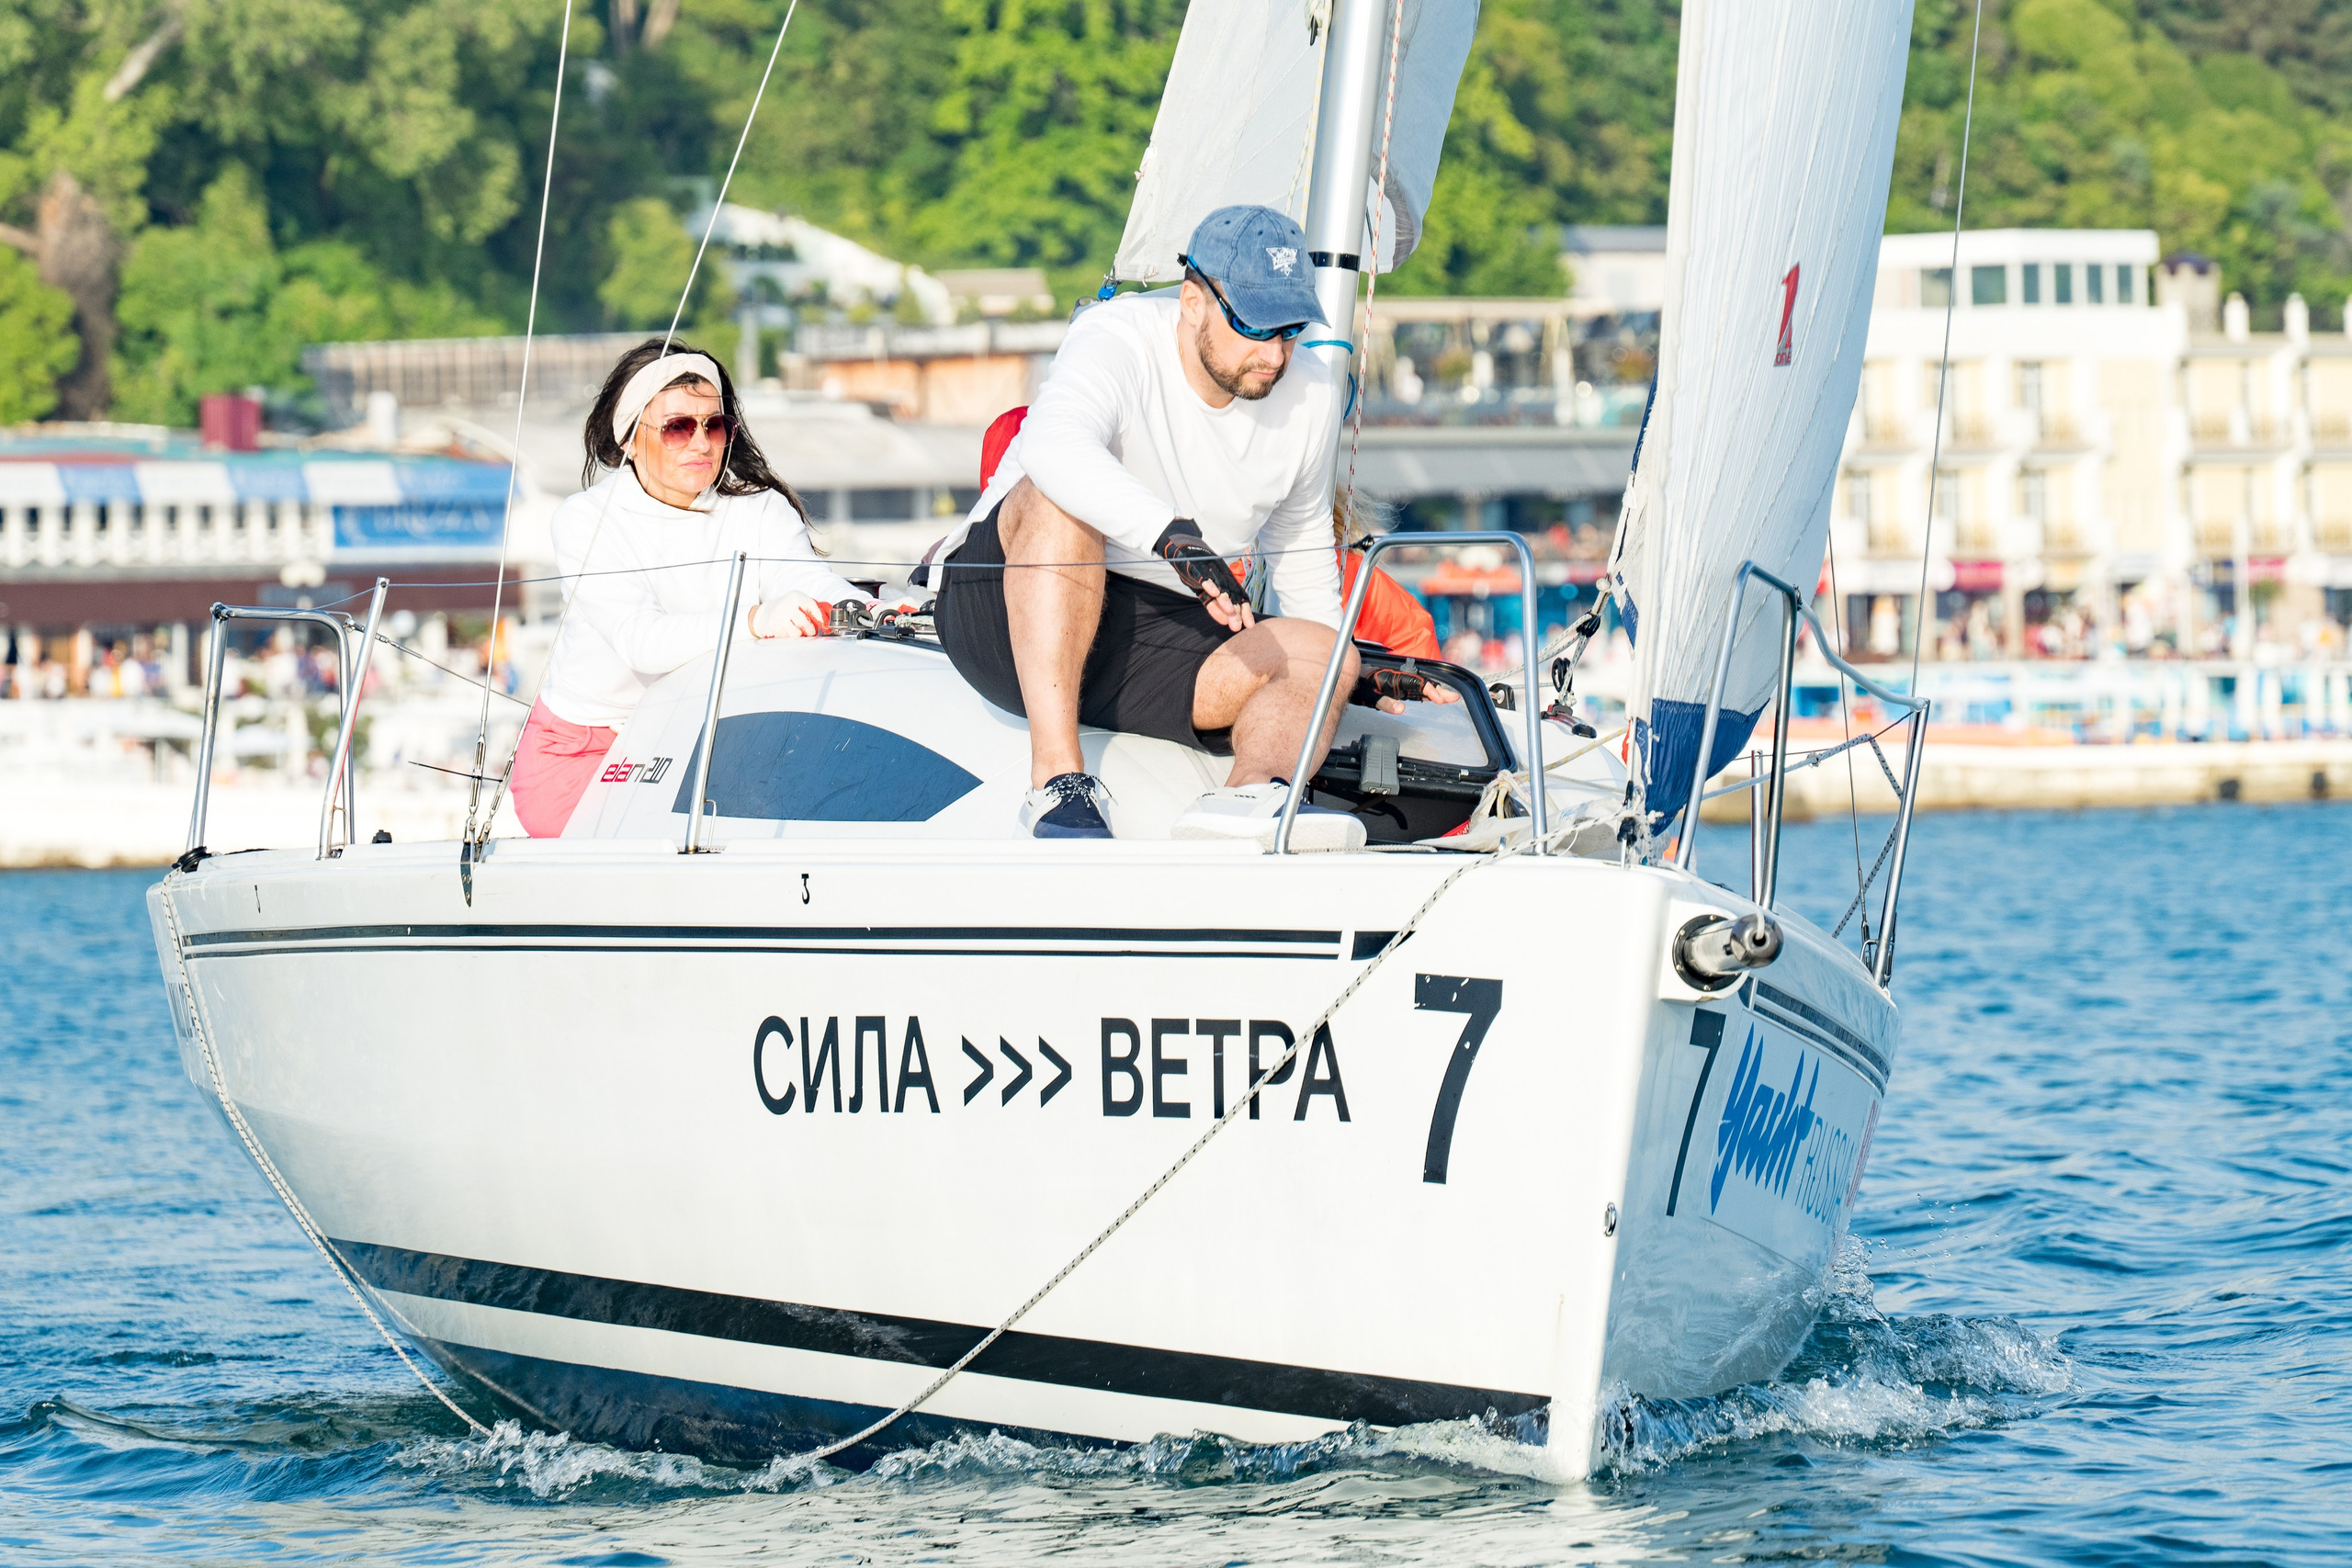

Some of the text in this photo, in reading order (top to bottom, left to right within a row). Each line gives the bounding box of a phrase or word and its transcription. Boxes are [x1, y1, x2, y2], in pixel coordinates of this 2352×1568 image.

[753, 1015, 1351, 1122] СИЛА ВЕТРА
[1415, 974, 1503, 1185] 7
[1666, 1007, 1727, 1217] 7
[1710, 1022, 1820, 1216] Yacht
